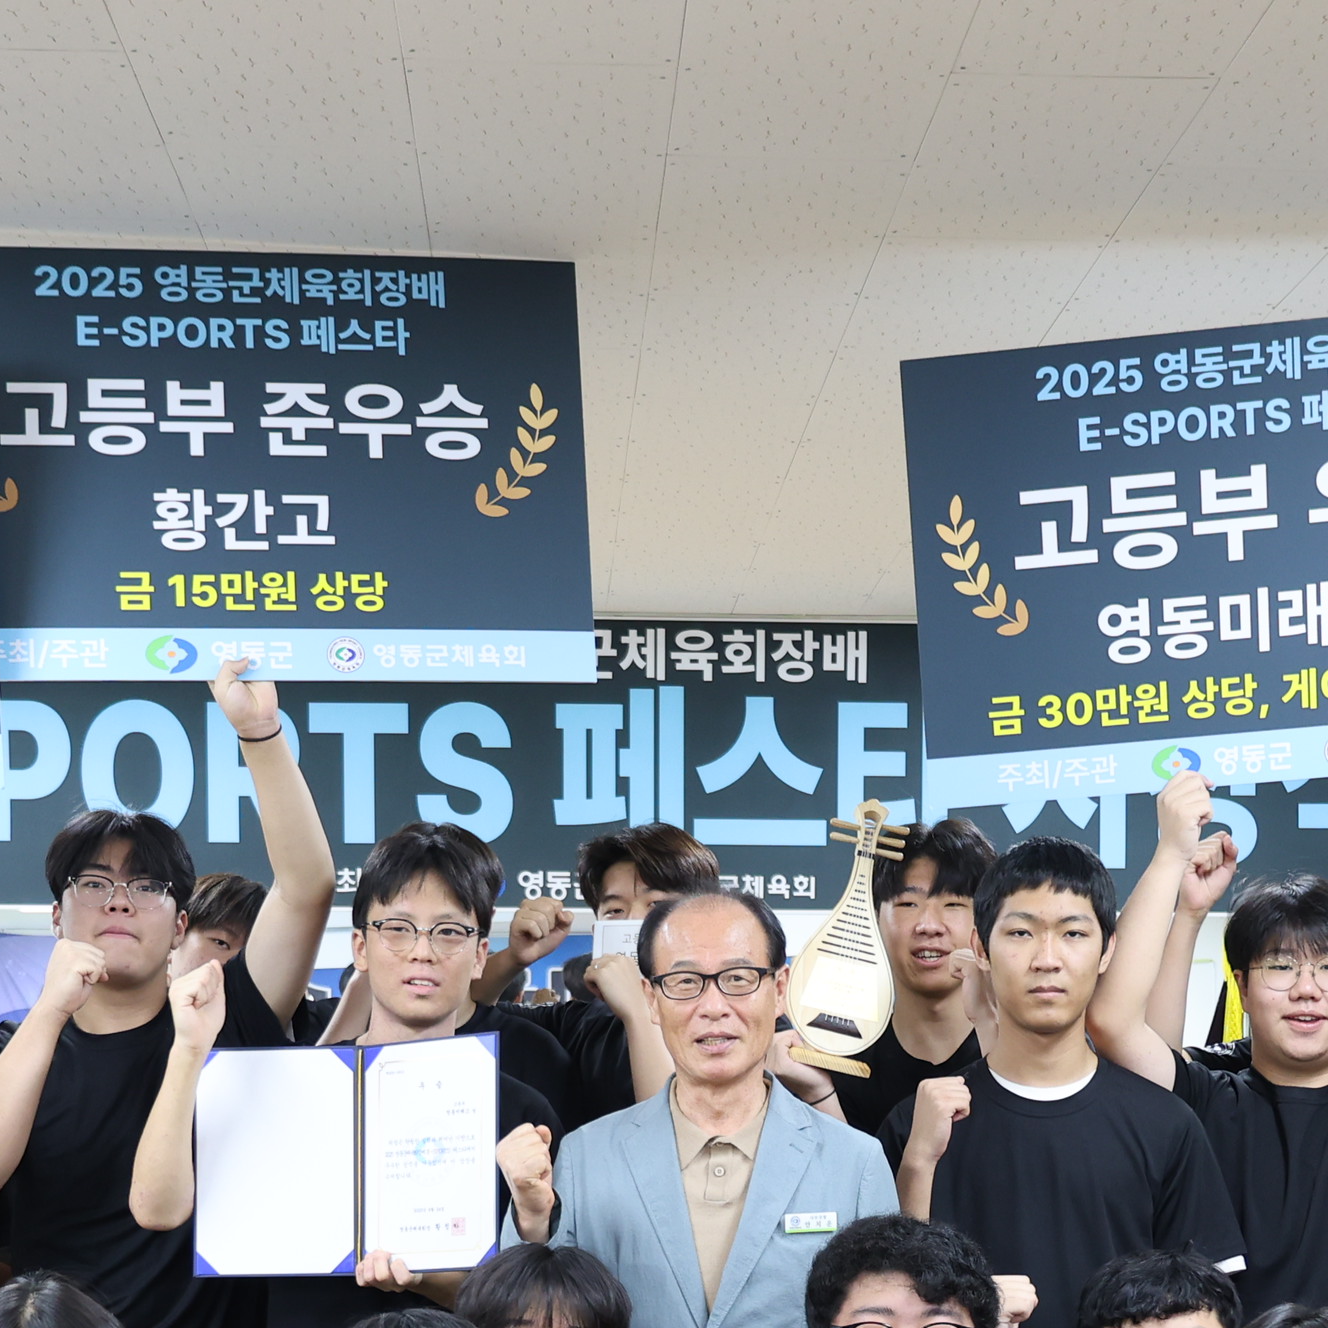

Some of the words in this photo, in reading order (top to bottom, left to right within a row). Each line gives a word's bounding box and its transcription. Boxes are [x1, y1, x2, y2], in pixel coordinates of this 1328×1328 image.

[35, 266, 142, 298] 2025
[155, 265, 445, 308] 영동군체육회장배
[77, 316, 290, 349] E-SPORTS
[301, 317, 410, 355] 페스타
[1036, 358, 1143, 401] 2025
[0, 379, 233, 456] 고등부
[260, 383, 488, 460] 준우승
[1078, 398, 1291, 451] E-SPORTS
[153, 489, 335, 550] 황간고
[1015, 464, 1277, 570] 고등부
[116, 572, 154, 610] 금
[168, 571, 297, 610] 15만원
[311, 572, 388, 611] 상당
[211, 641, 293, 669] 영동군
[373, 644, 526, 668] 영동군체육회
[596, 627, 868, 684] 체육회장배
[989, 696, 1025, 736] 금
[1038, 681, 1169, 728] 30만원
[1182, 674, 1268, 718] 상당,
[997, 754, 1117, 792] 주최/주관
[1214, 742, 1292, 775] 영동군
[719, 873, 816, 899] 체육회
